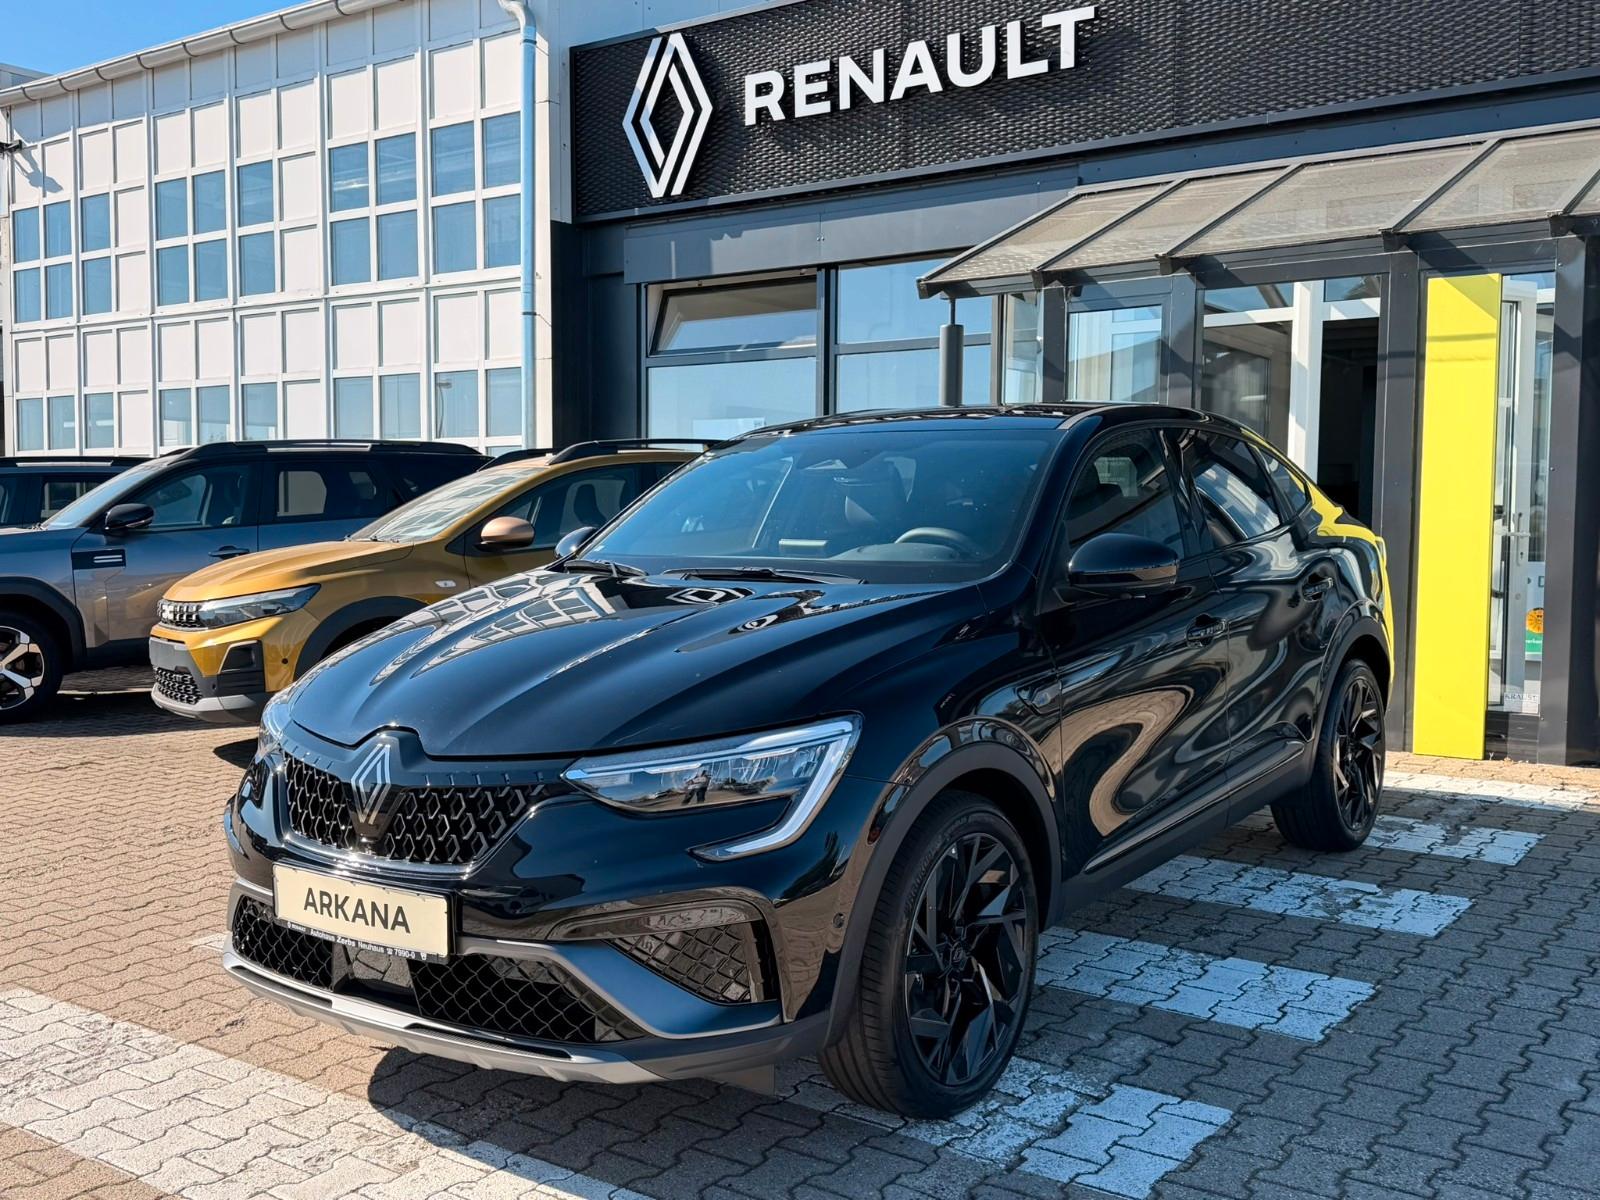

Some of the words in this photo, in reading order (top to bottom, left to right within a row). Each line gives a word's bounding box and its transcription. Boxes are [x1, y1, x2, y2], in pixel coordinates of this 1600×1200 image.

[744, 6, 1095, 126] RENAULT
[304, 887, 411, 934] ARKANA
[310, 928, 336, 942] Autohaus
[358, 941, 385, 954] Neuhaus
